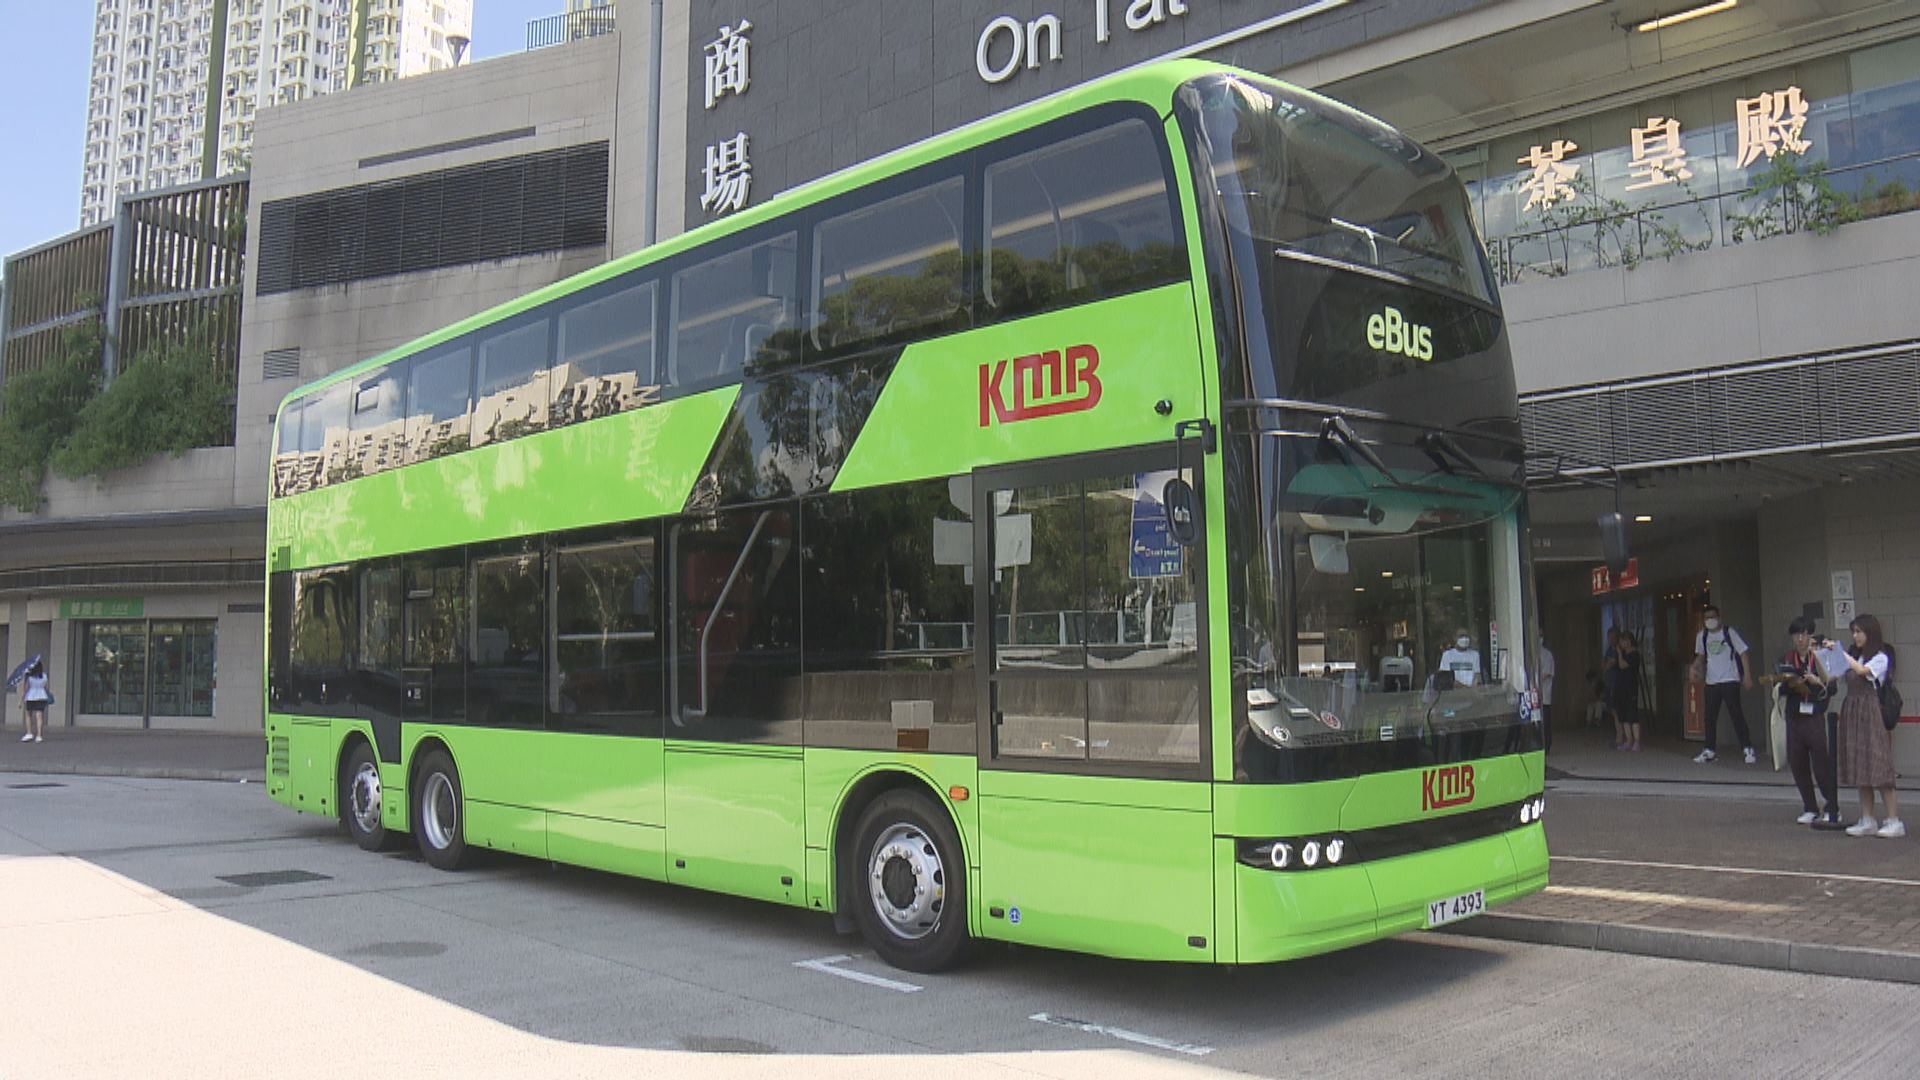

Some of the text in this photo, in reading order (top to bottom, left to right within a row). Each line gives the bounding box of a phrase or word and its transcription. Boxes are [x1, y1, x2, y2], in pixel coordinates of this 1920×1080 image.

[976, 0, 1188, 83] On Ta
[700, 18, 753, 215] 商場
[1517, 86, 1812, 212] 茶皇殿
[1367, 305, 1433, 361] eBus
[979, 344, 1102, 427] KMB
[1422, 764, 1475, 811] KMB
[1430, 892, 1482, 923] YT 4393
